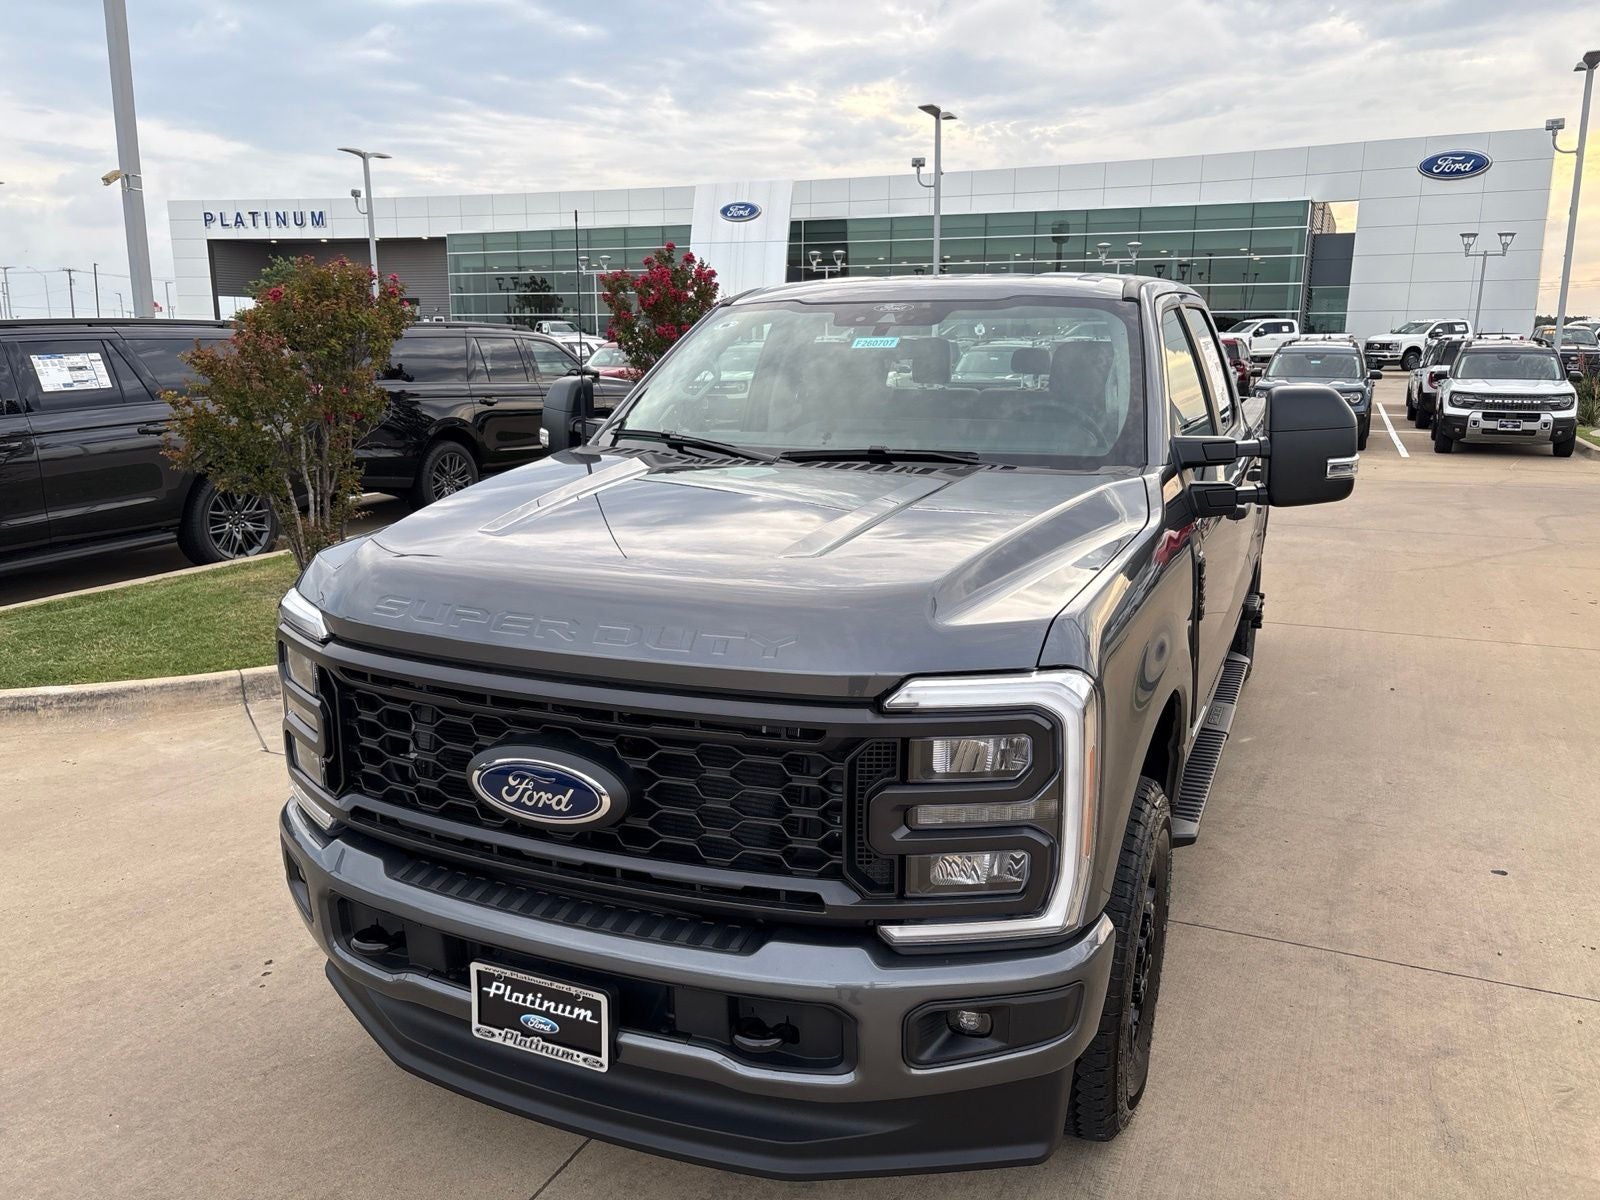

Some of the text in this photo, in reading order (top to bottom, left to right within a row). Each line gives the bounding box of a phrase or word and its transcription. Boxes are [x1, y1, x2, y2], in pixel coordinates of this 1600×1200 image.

[1432, 155, 1475, 173] Ford
[203, 210, 327, 229] PLATINUM
[726, 205, 751, 217] Ford
[855, 339, 896, 347] F260707
[372, 594, 798, 660] SUPER DUTY
[501, 770, 575, 812] Ford
[482, 981, 599, 1024] Platinum
[527, 1016, 551, 1032] Ford
[503, 1029, 574, 1061] Platinum
